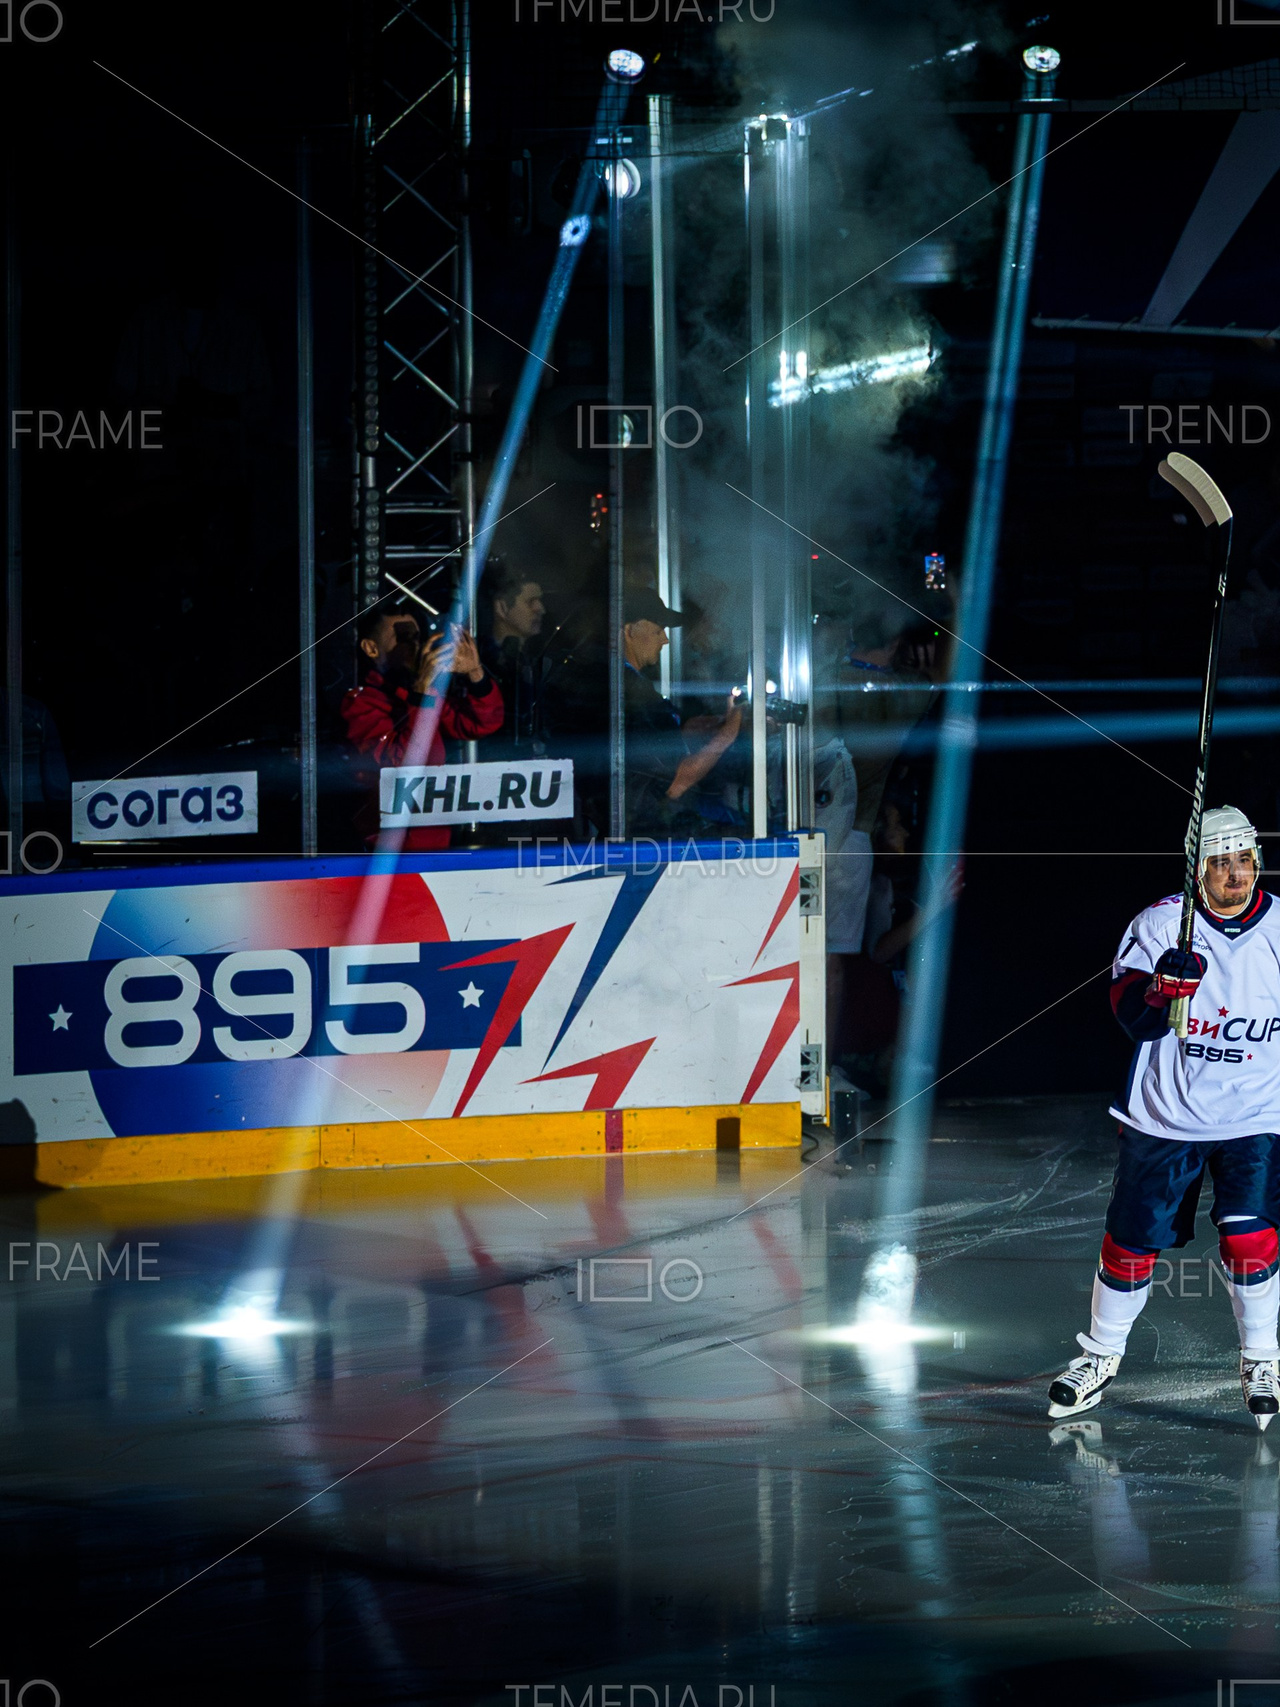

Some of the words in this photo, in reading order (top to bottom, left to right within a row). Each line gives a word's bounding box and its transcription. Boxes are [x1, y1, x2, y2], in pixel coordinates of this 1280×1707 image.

[391, 769, 563, 814] KHL.RU
[102, 942, 427, 1069] 895
[1186, 1042, 1244, 1064] 895
